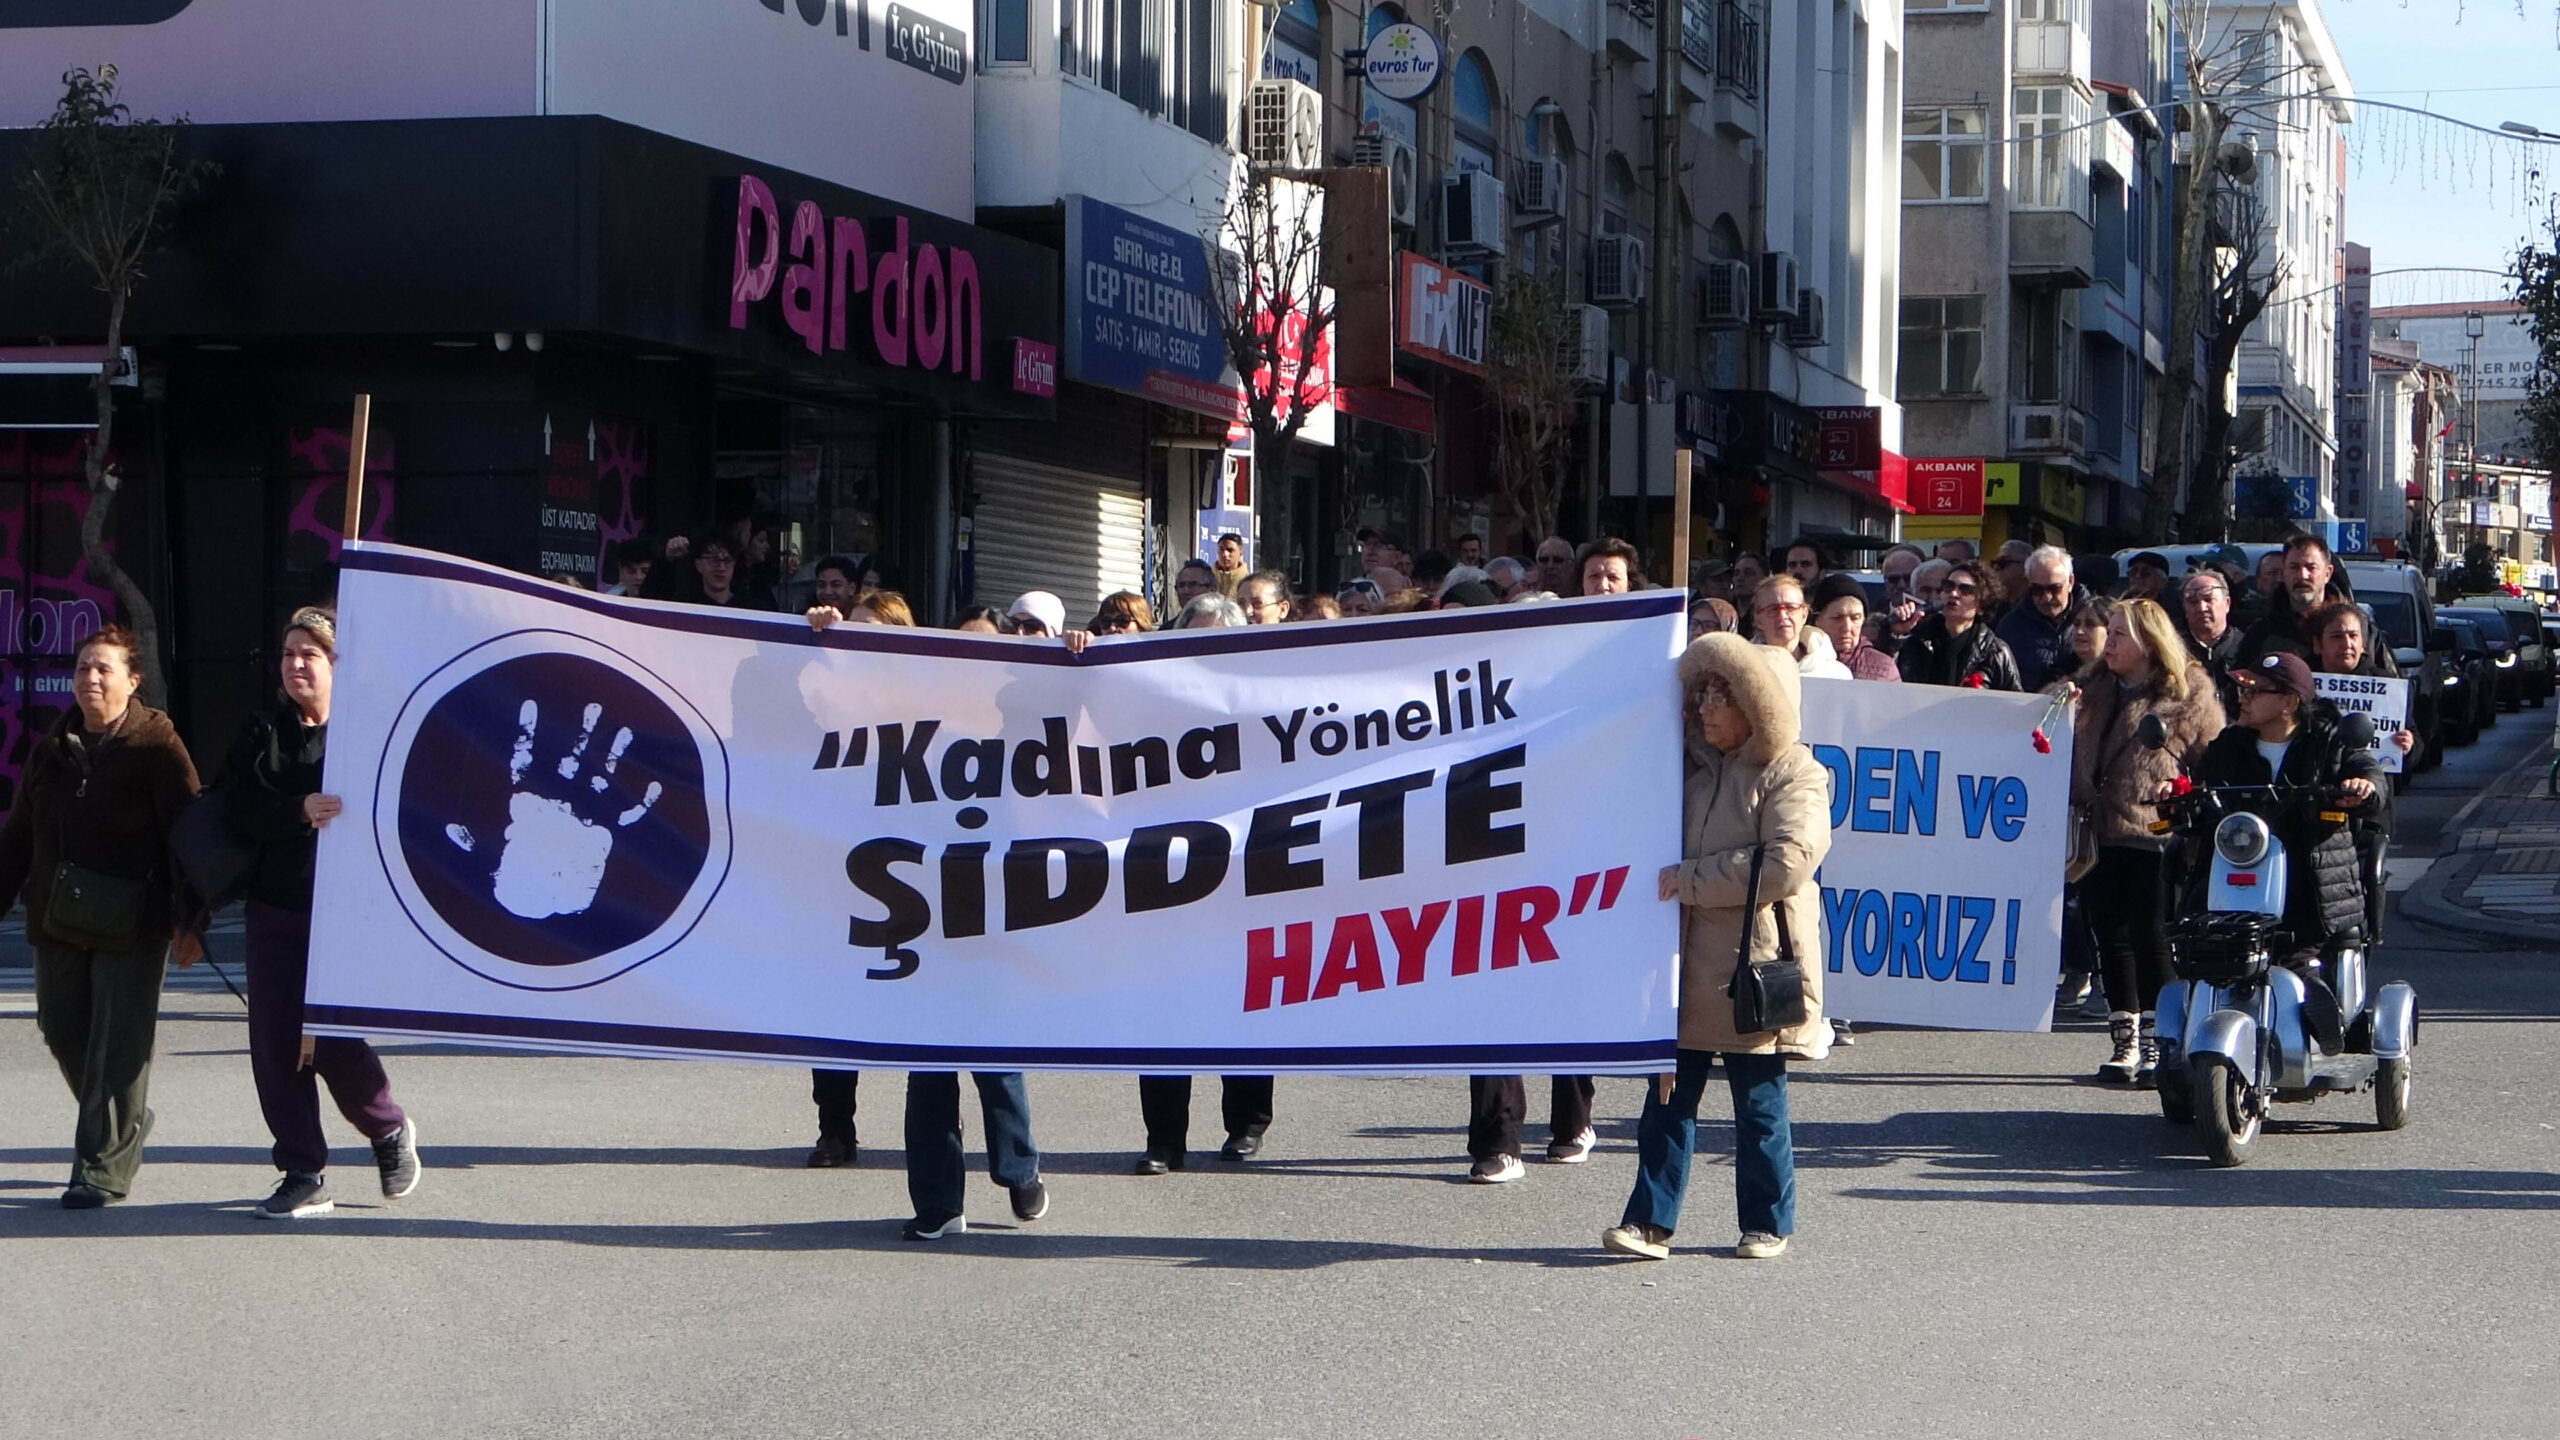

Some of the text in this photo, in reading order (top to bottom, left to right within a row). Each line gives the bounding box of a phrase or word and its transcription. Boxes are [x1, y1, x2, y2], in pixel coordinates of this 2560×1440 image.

[891, 5, 909, 62] İç
[912, 23, 961, 74] Giyim
[1370, 55, 1434, 73] evros tur
[1113, 235, 1143, 267] SIFIR
[1144, 251, 1158, 273] ve
[1086, 259, 1120, 308] CEP
[1815, 410, 1873, 420] KBANK
[1829, 450, 1845, 463] 24
[1914, 463, 1977, 473] AKBANK
[2346, 423, 2364, 519] HOTE
[541, 503, 558, 528] ÜST
[1936, 496, 1953, 508] 24
[2328, 679, 2387, 695] SESSİZ
[1261, 658, 1519, 765] Yönelik
[1809, 744, 2029, 842] DEN ve
[843, 742, 1527, 981] ŞİDDETE
[1815, 886, 2021, 985] YORUZ!
